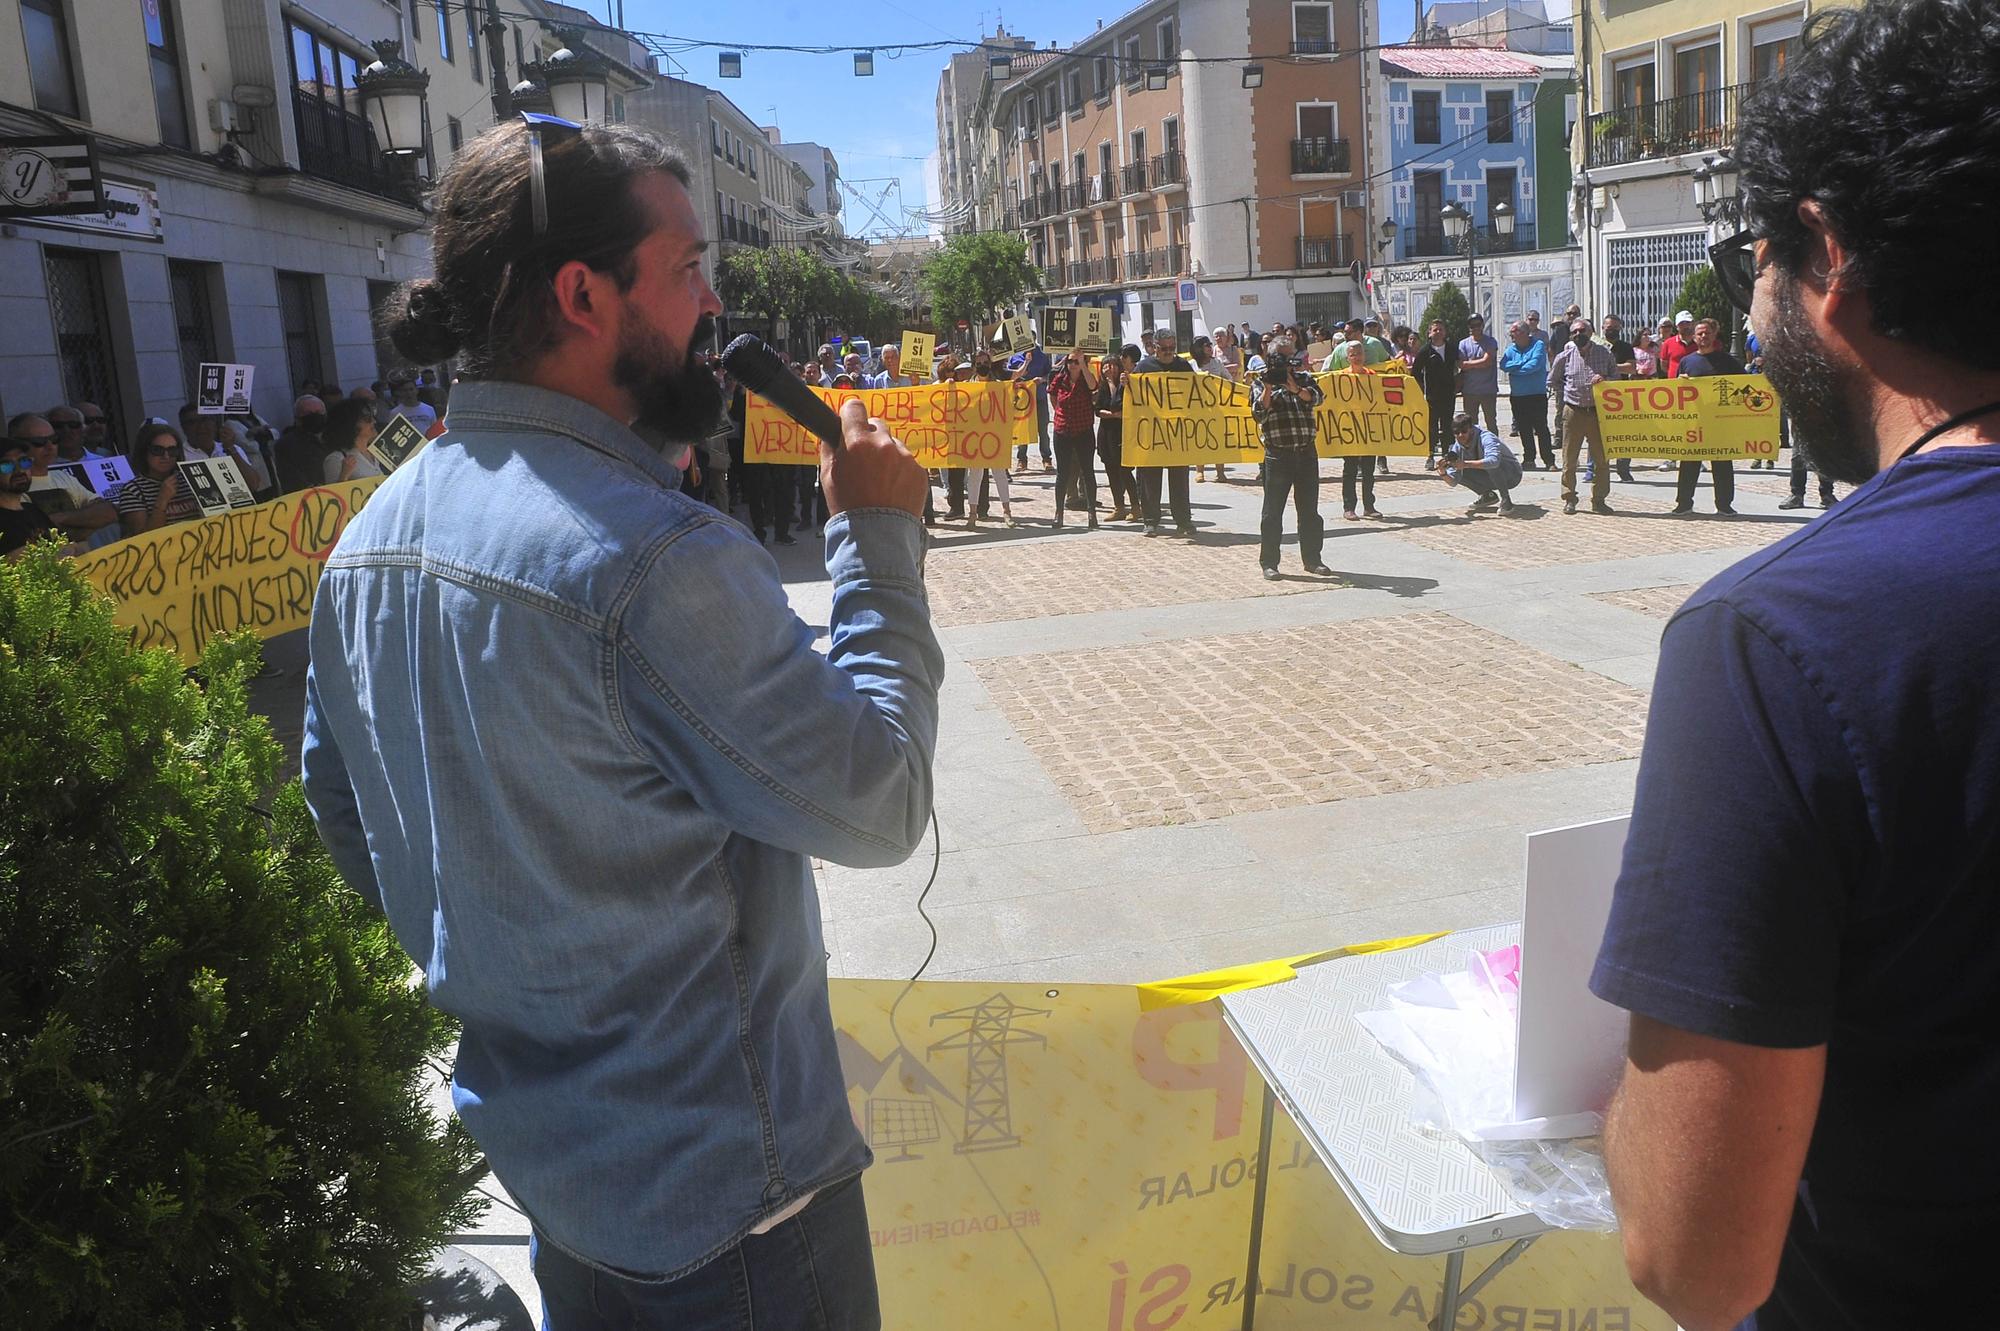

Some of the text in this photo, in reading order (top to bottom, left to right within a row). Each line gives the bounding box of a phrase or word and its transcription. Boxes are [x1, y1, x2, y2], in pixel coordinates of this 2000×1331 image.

[1436, 265, 1489, 280] PERFUMRIA
[1054, 310, 1067, 319] ASÍ
[1013, 319, 1021, 327] ASÍ
[1053, 319, 1067, 331] NO
[1088, 319, 1099, 333] SÍ
[1014, 325, 1024, 335] SÍ
[913, 336, 924, 344] ASÍ
[912, 343, 923, 356] SÍ
[207, 368, 219, 377] ASÍ
[235, 368, 245, 377] ASÍ
[206, 378, 218, 390] NO
[234, 376, 244, 390] SÍ
[1602, 386, 1699, 413] STOP
[870, 390, 924, 423] DEBE
[930, 390, 971, 424] SER
[978, 389, 1008, 423] UN
[1605, 413, 1670, 421] MACROCENTRAL
[391, 431, 408, 448] NO
[1137, 417, 1219, 451] CAMPOS
[1606, 427, 1703, 443] ENERGÍA SOLAR SÍ
[1607, 440, 1773, 456] ATENTADO MEDIOAMBIENTAL NO
[100, 461, 114, 470] ASÍ
[189, 464, 203, 476] ASÍ
[217, 461, 228, 470] ASÍ
[104, 468, 121, 482] SÍ
[222, 469, 235, 485] SÍ
[196, 475, 210, 489] NO
[175, 501, 290, 587] PARAJES
[300, 490, 341, 553] NO
